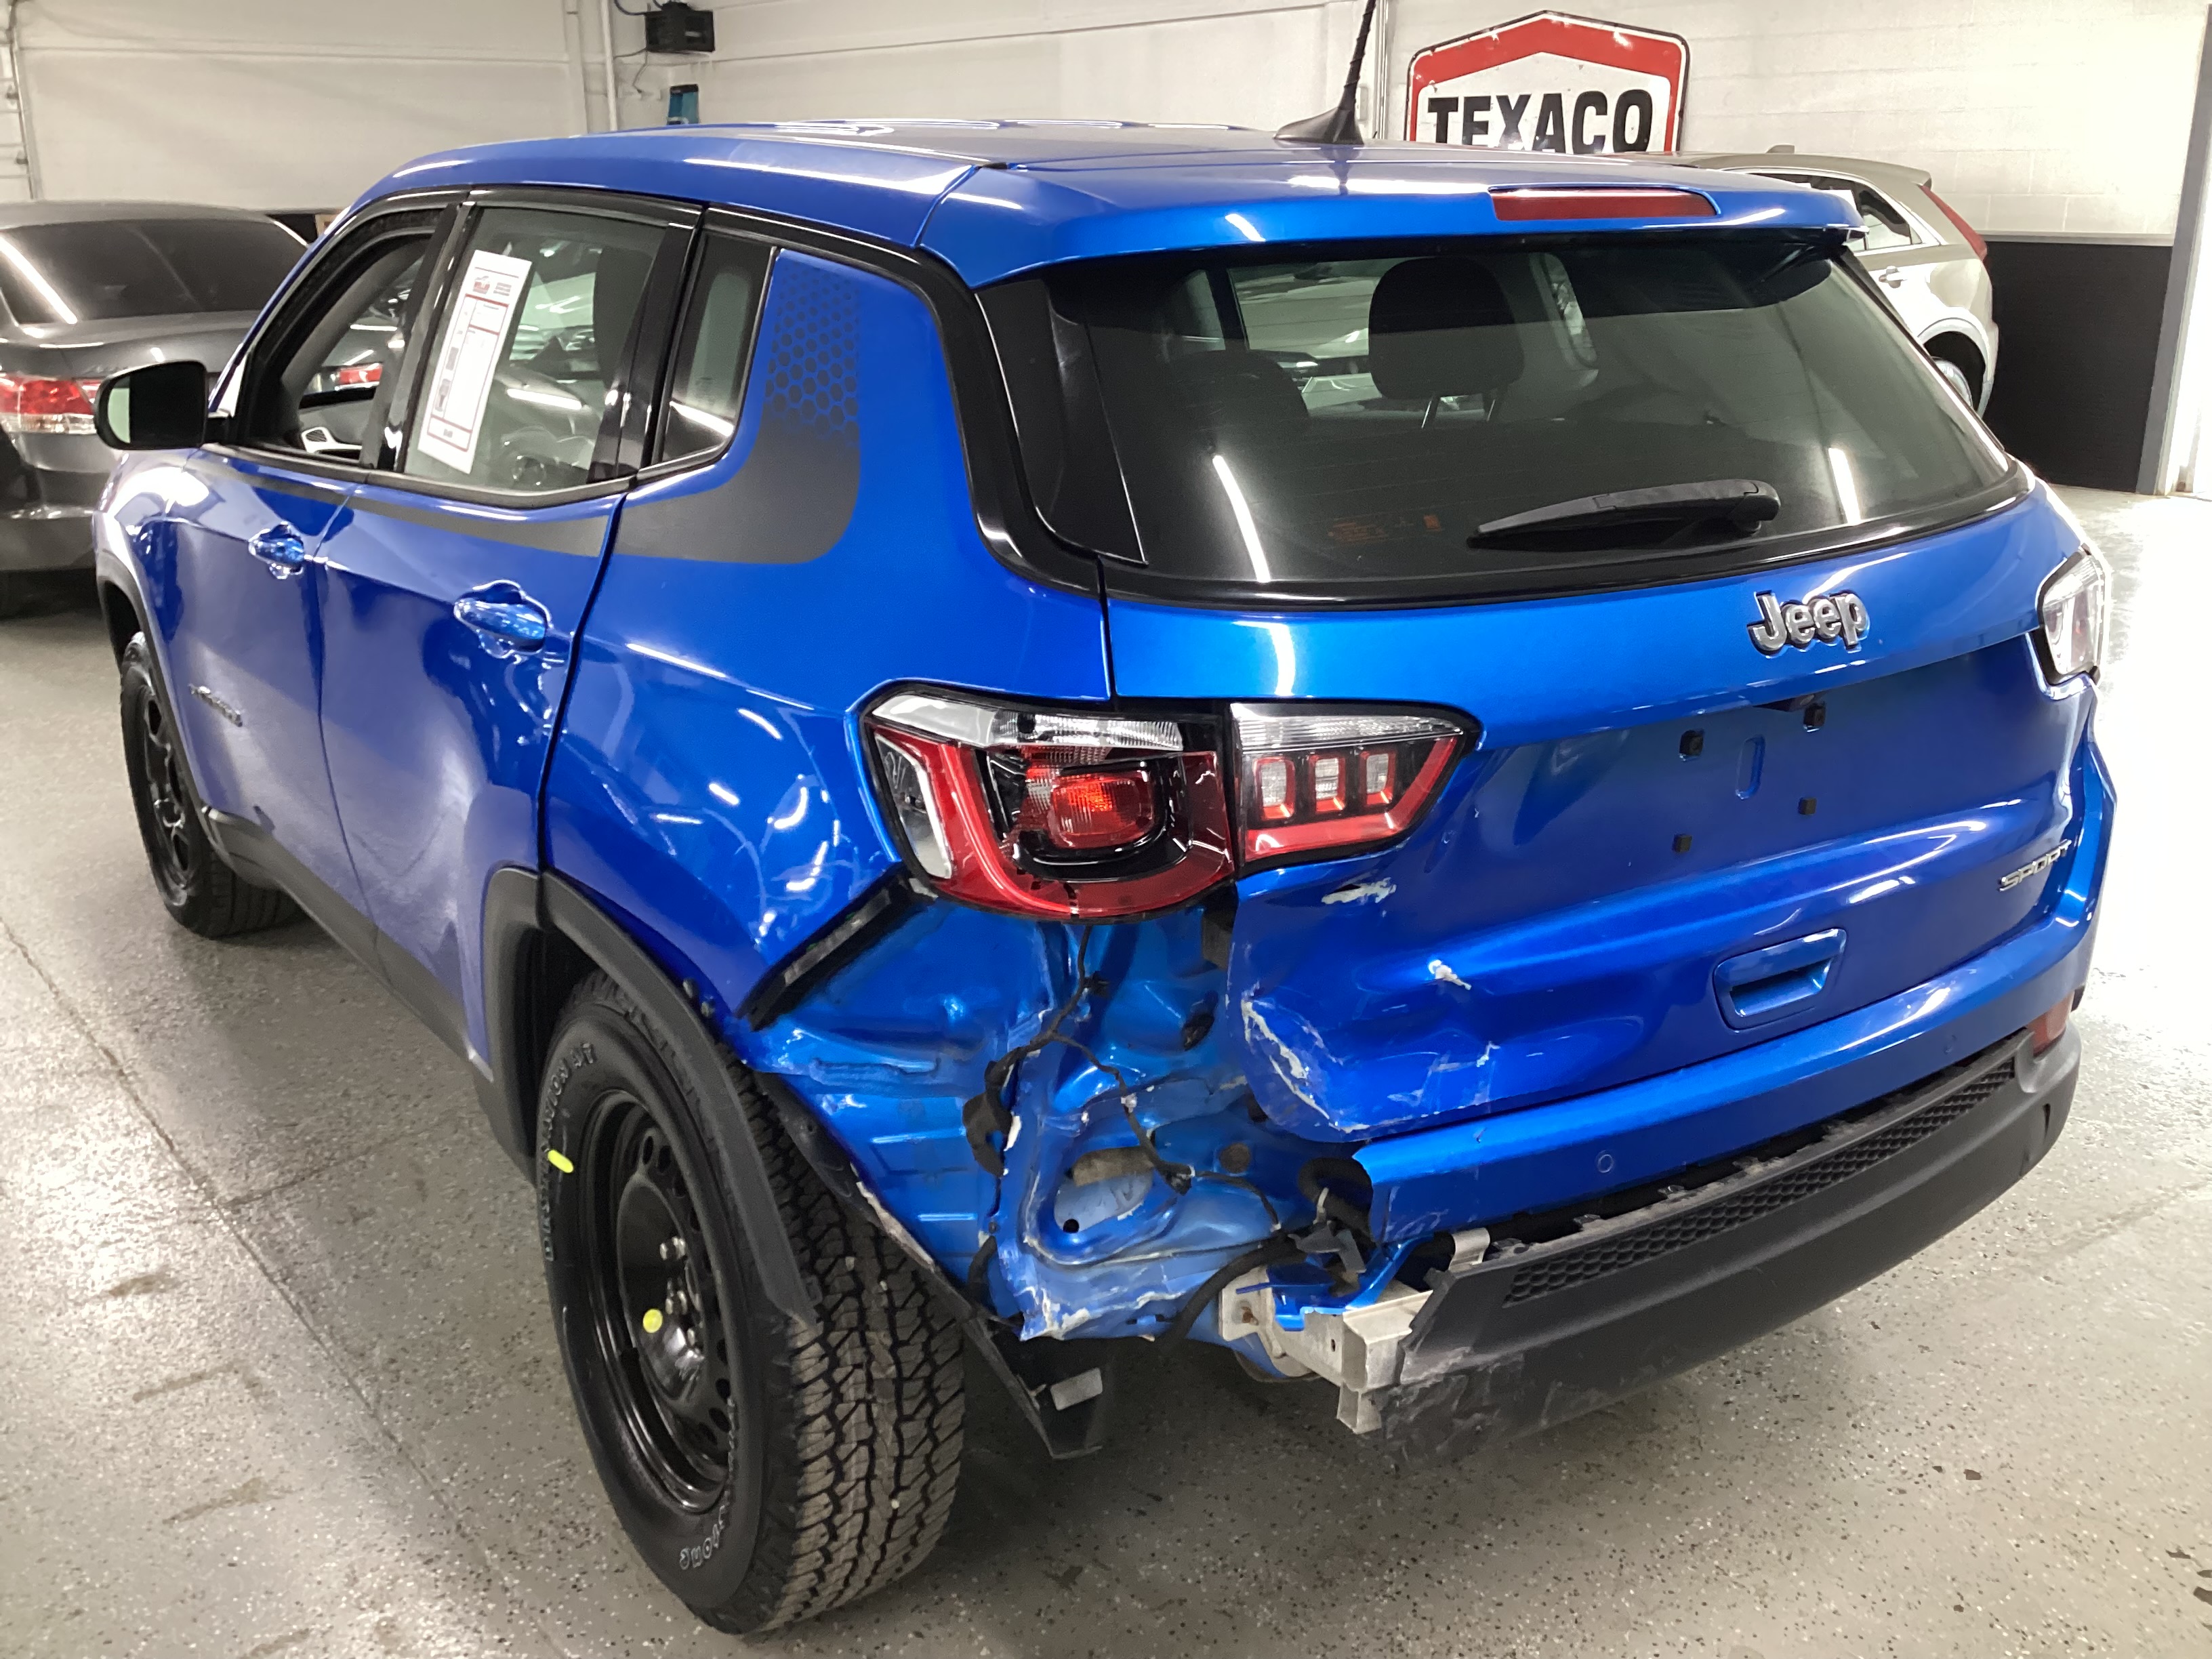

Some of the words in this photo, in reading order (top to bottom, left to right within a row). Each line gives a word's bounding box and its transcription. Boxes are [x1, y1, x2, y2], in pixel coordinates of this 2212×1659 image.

[1427, 89, 1653, 154] TEXACO
[1747, 590, 1869, 656] Jeep
[1999, 839, 2072, 891] SPORT
